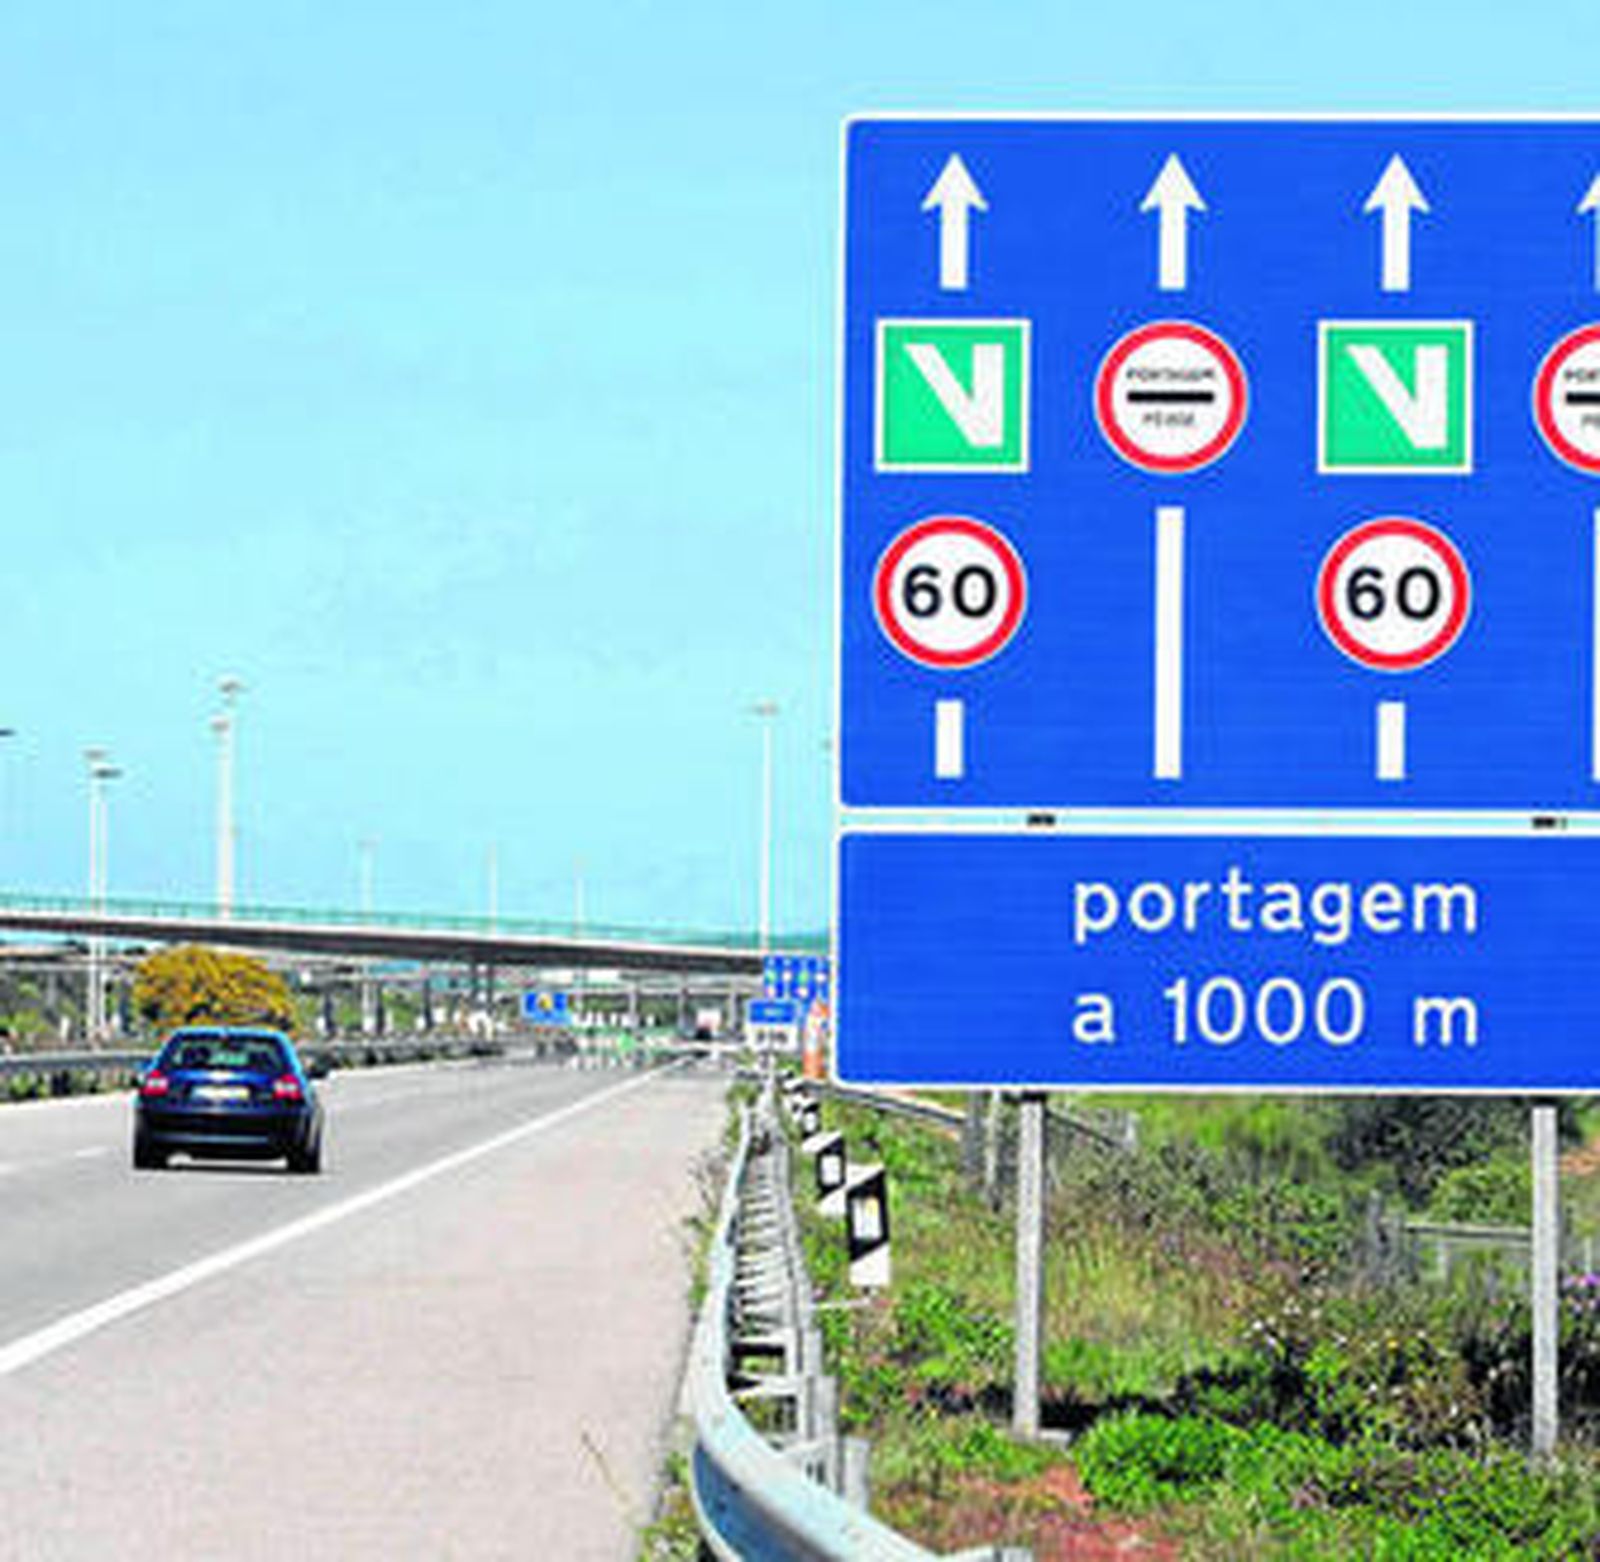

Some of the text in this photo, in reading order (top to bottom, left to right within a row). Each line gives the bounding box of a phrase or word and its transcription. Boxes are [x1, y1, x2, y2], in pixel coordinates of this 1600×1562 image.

[902, 564, 998, 619] 60
[1346, 566, 1441, 621] 60
[1074, 867, 1477, 945] portagem
[1072, 976, 1478, 1046] a 1000 m
